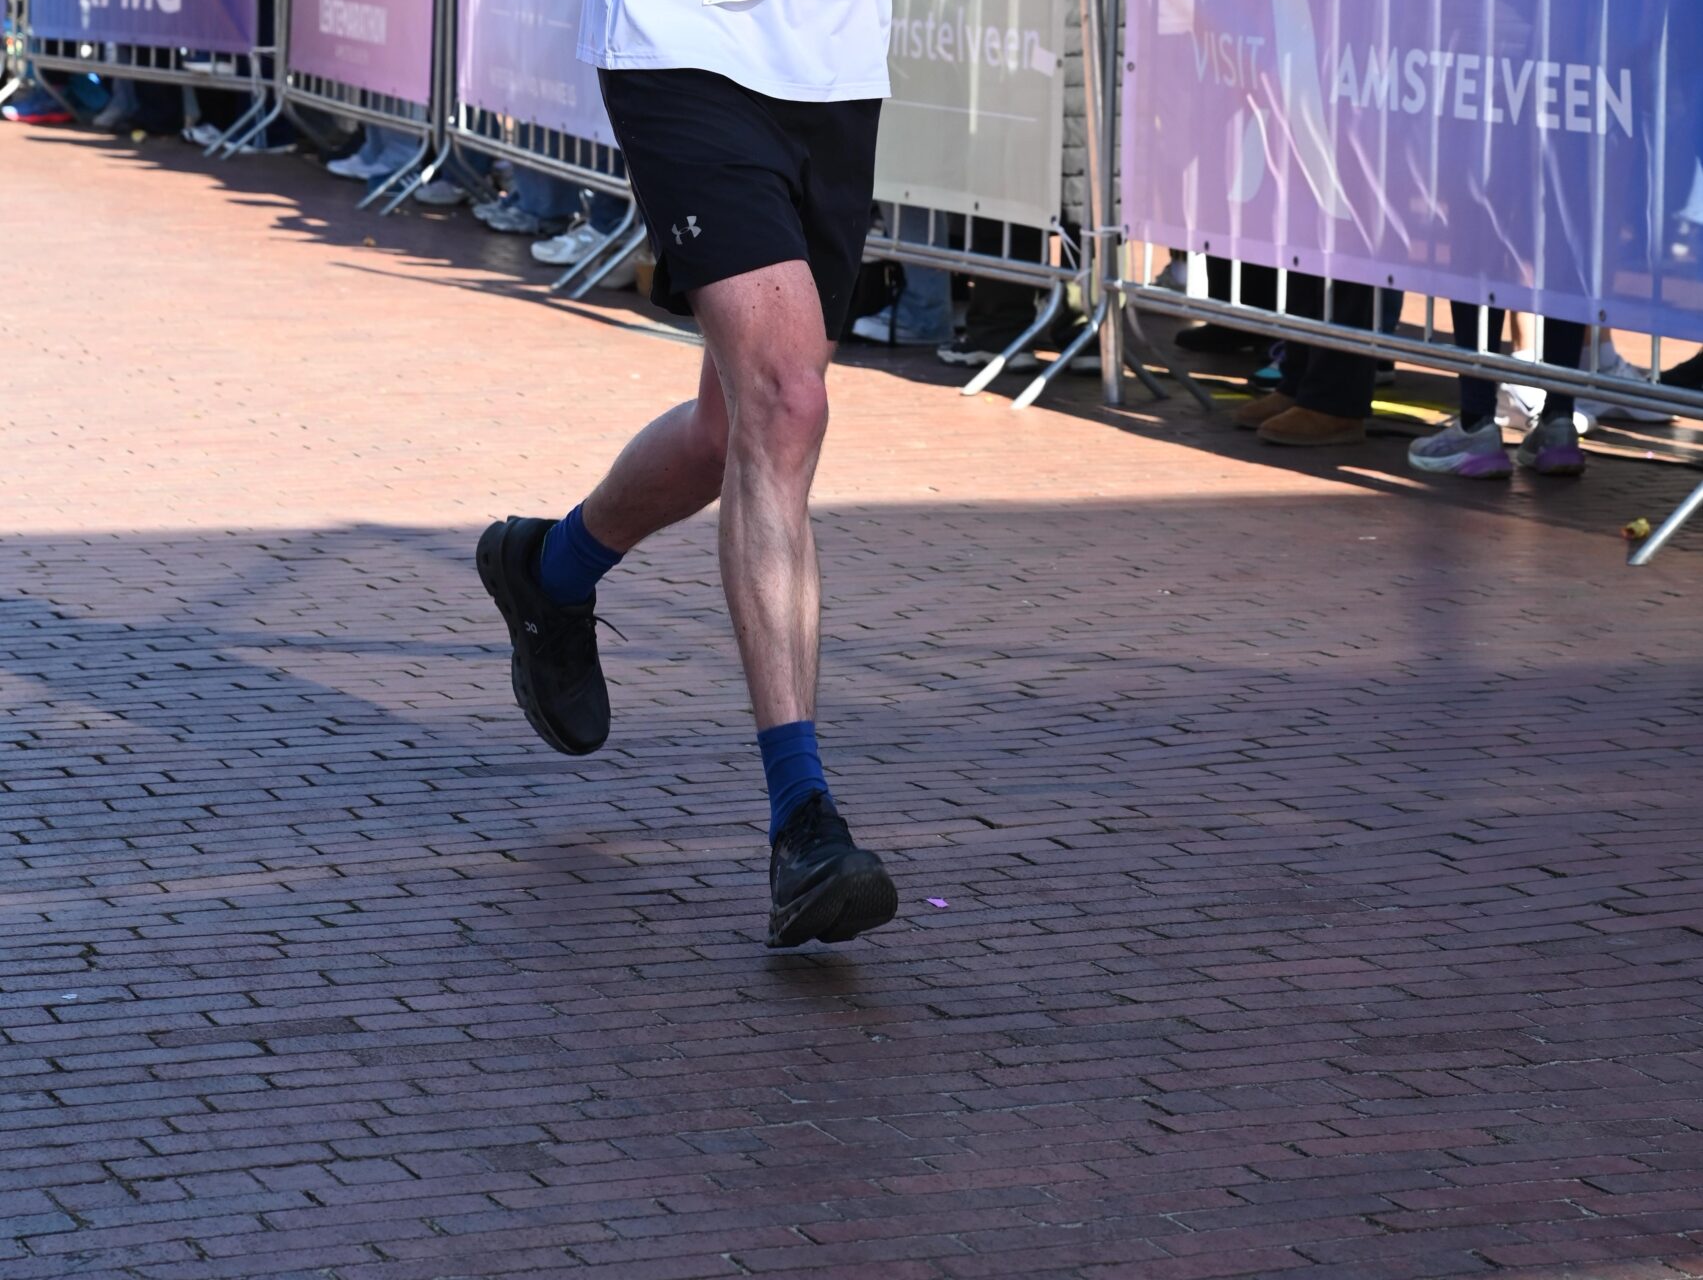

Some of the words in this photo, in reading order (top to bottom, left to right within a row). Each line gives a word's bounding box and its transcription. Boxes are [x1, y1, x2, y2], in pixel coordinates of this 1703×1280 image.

[890, 4, 1041, 72] mstelveen
[1189, 30, 1266, 90] VISIT
[1329, 42, 1633, 138] AMSTELVEEN
